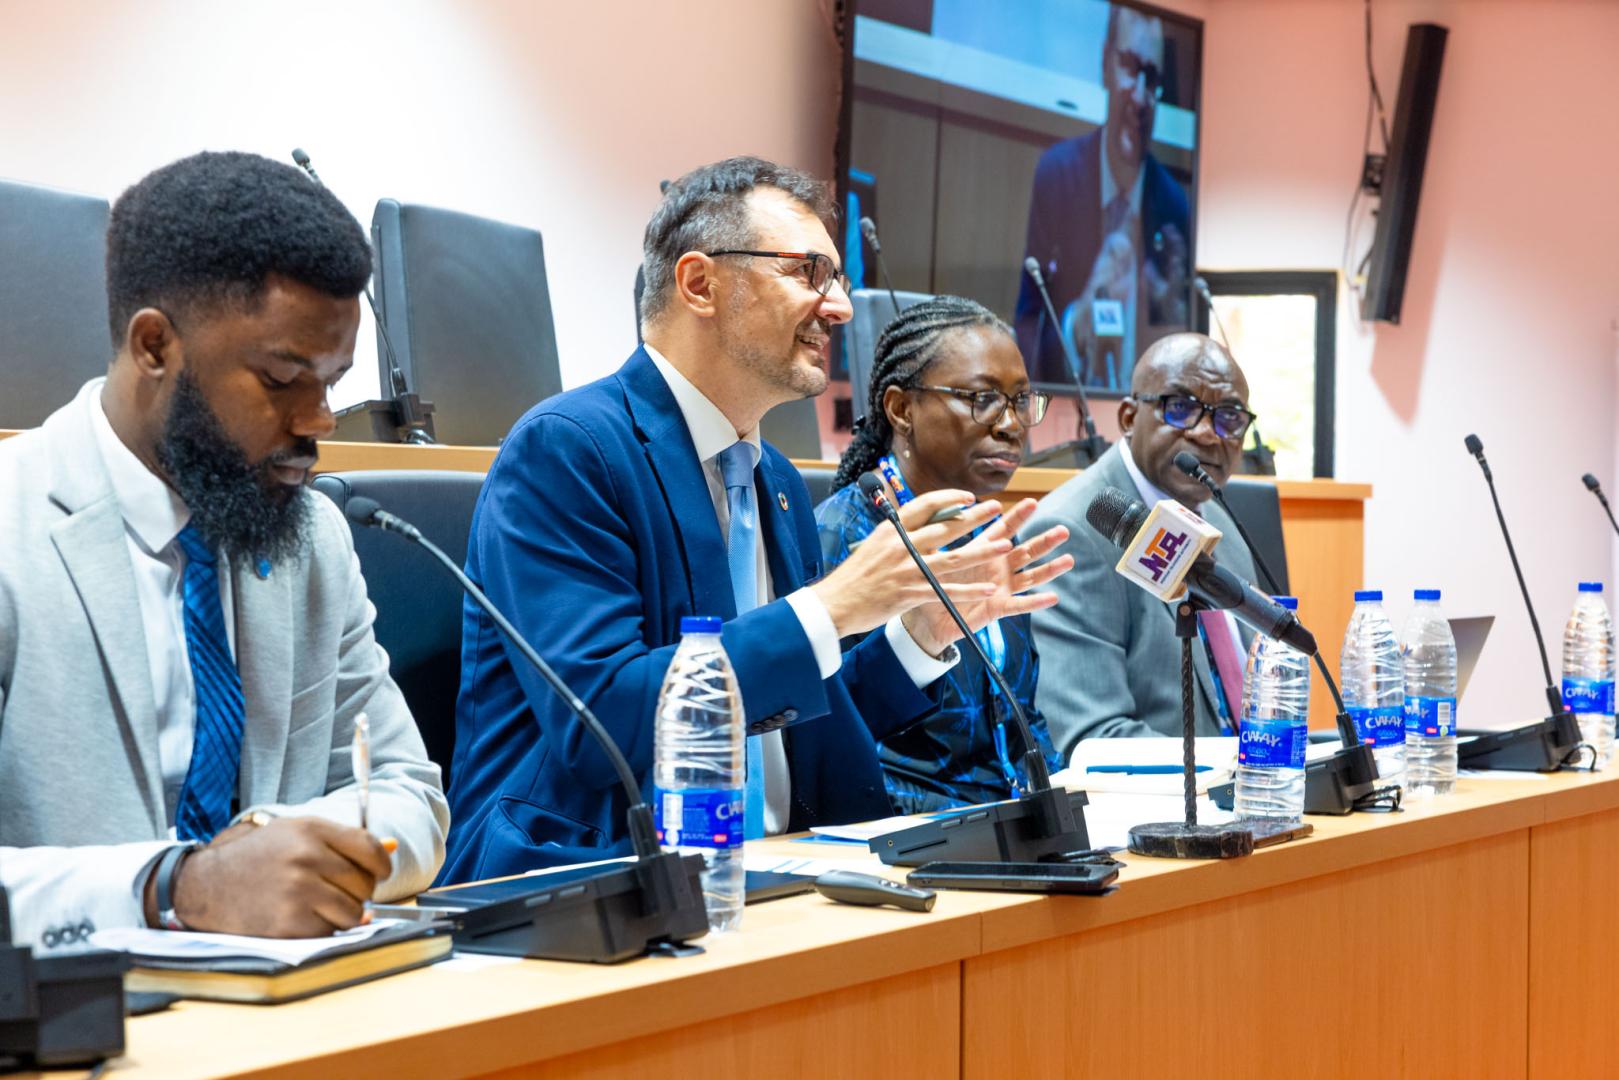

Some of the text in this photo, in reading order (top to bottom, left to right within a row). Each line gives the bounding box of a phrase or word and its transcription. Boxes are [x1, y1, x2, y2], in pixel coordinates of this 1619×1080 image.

[1138, 527, 1188, 582] NTA
[1365, 715, 1402, 728] CWAY
[1241, 730, 1280, 748] CWAY
